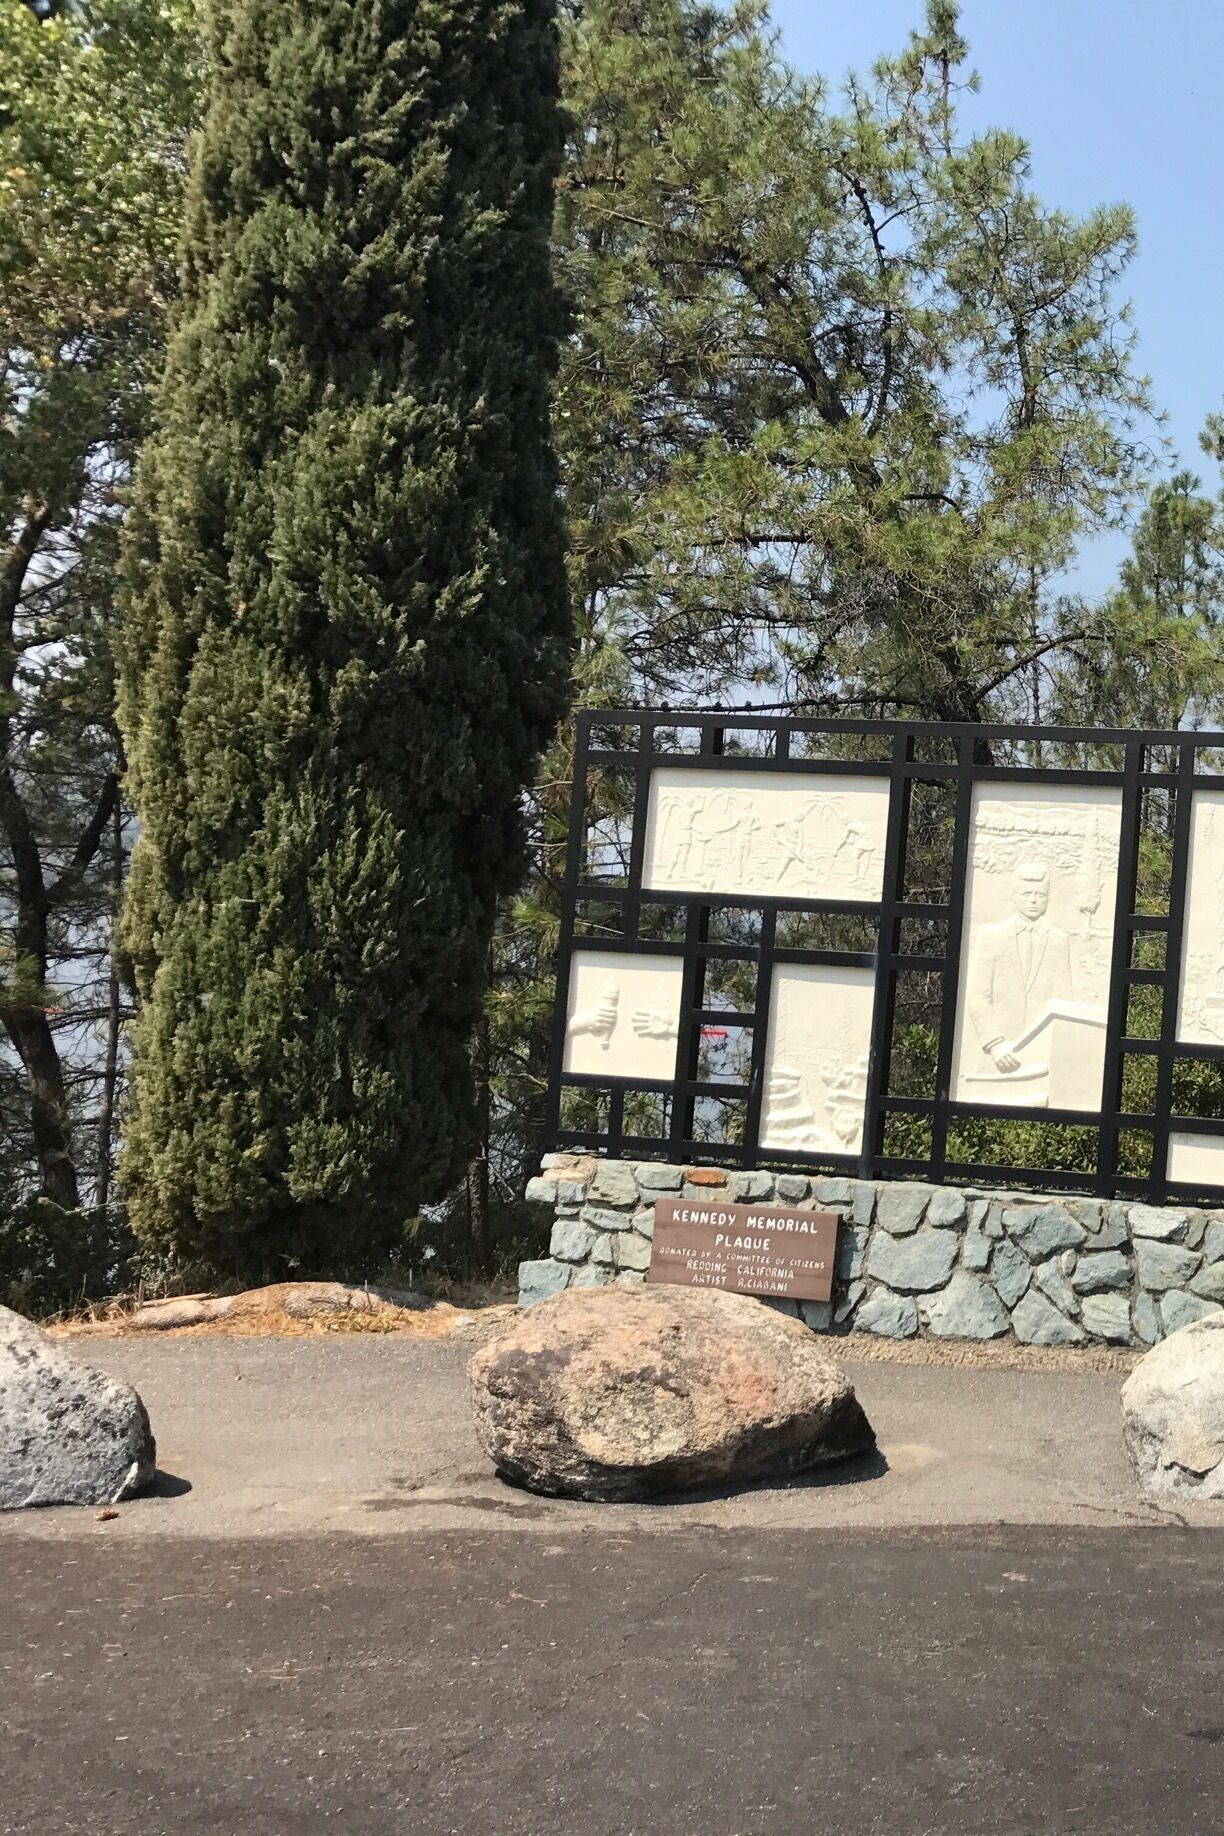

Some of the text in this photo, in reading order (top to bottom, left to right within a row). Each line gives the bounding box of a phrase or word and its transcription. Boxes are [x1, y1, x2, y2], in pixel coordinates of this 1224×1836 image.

[673, 1209, 818, 1234] KENNEDY MEMORIAL
[715, 1234, 770, 1250] PLAQUE
[659, 1247, 697, 1257] DONATED
[701, 1250, 711, 1258] BY
[716, 1252, 722, 1260] A
[726, 1253, 771, 1264] COMMITTEE
[790, 1259, 825, 1270] CITIZENS
[686, 1260, 795, 1279] REDDING CALIFORNIA
[691, 1274, 727, 1287] ARTIST
